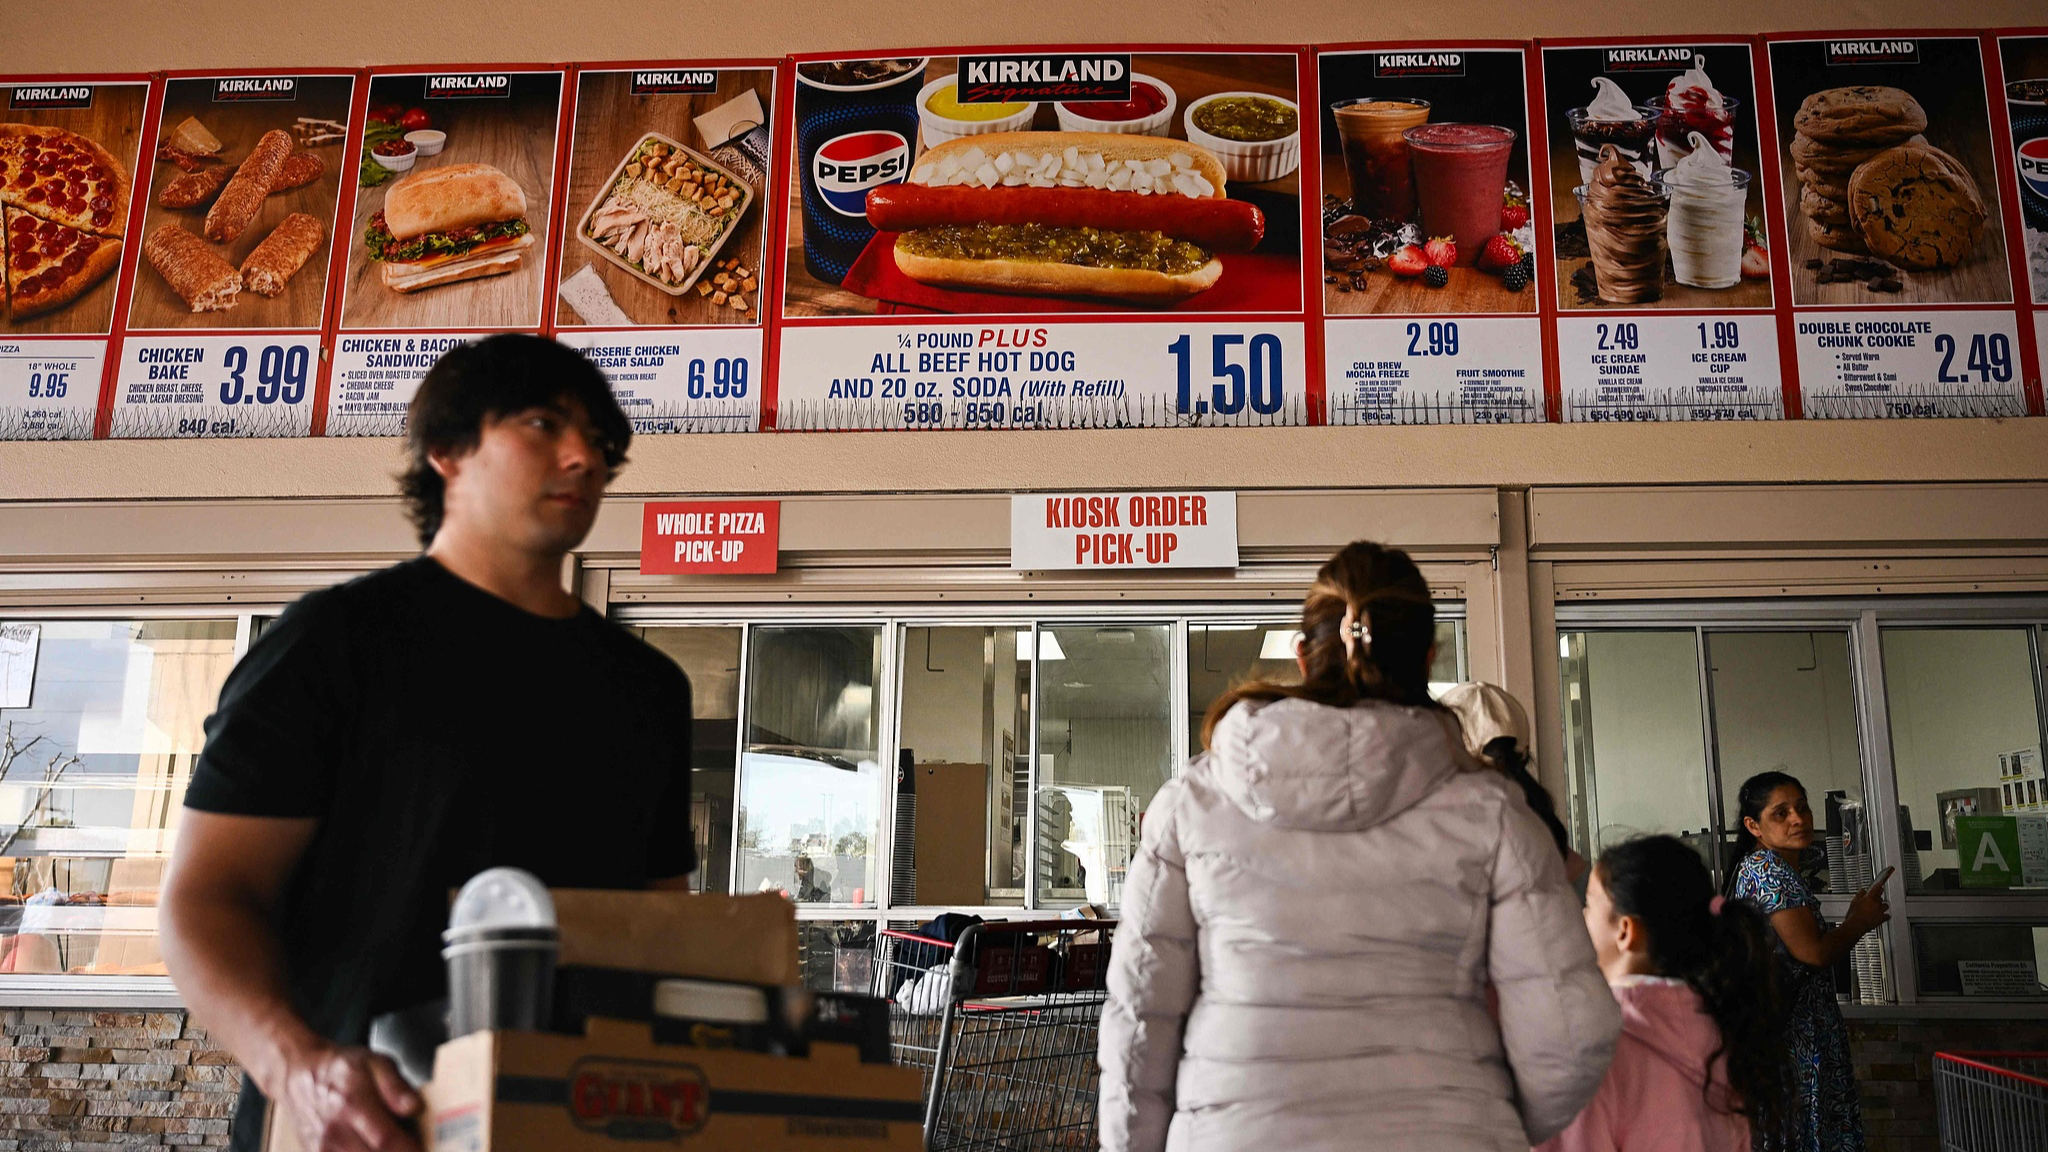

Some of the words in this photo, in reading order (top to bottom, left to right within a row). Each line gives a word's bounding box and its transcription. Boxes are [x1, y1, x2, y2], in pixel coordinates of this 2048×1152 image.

[1831, 42, 1914, 55] KIRKLAND
[1379, 54, 1461, 67] KIRKLAND
[1609, 49, 1691, 62] KIRKLAND
[968, 60, 1124, 83] KIRKLAND
[431, 76, 507, 89] KIRKLAND
[637, 72, 714, 85] KIRKLAND
[219, 79, 294, 92] KIRKLAND
[15, 88, 90, 101] KIRKLAND
[967, 82, 1124, 103] Signature
[818, 153, 905, 183] PEPSI
[1799, 322, 1850, 334] DOUBLE
[1855, 322, 1931, 334] CHOCOLATE
[917, 333, 973, 348] POUND
[978, 328, 1048, 348] PLUS
[1406, 322, 1459, 356] 2.99
[1596, 323, 1639, 350] 2.49
[1698, 321, 1739, 349] 1.99
[1818, 336, 1863, 348] CHUNK
[1867, 335, 1915, 347] COOKIE
[342, 339, 400, 352] CHICKEN
[405, 339, 416, 352] &
[635, 346, 680, 356] CHICKEN
[138, 348, 204, 362] CHICKEN
[366, 354, 439, 368] SANDWICH
[1592, 354, 1608, 364] ICE
[1611, 354, 1646, 363] CREAM
[1692, 353, 1708, 362] ICE
[1710, 353, 1747, 362] CREAM
[1934, 333, 2013, 383] 2.49
[44, 363, 77, 371] WHOLE
[630, 357, 664, 367] SALAD
[871, 353, 910, 373] ALL
[919, 352, 970, 373] BEEF
[978, 351, 1022, 372] HOT
[1030, 351, 1075, 372] DOG
[1353, 362, 1375, 370] COLD
[1377, 361, 1402, 370] BREW
[1710, 364, 1730, 373] CUP
[1843, 363, 1851, 371] All
[1852, 363, 1869, 371] Butter
[149, 365, 189, 379] BAKE
[219, 345, 310, 405] 3.99
[347, 371, 368, 380] SLICED
[369, 370, 384, 379] OVEN
[385, 370, 411, 379] ROASTED
[1168, 333, 1282, 415] 1.50
[1346, 370, 1376, 378] MOCHA
[1378, 369, 1409, 378] FREEZE
[1456, 370, 1480, 378] FRUIT
[1482, 369, 1525, 377] SMOOTHIE
[1599, 365, 1640, 375] SUNDAE
[688, 358, 749, 399] 6.99
[1844, 373, 1876, 381] Bittersweet
[1877, 373, 1882, 381] &
[1883, 373, 1897, 381] Semi
[29, 373, 69, 398] 9.95
[129, 383, 154, 393] CHICKEN
[346, 381, 372, 390] CHEDDAR
[373, 381, 395, 390] CHEESE
[829, 378, 874, 399] AND
[881, 378, 907, 398] 20
[914, 381, 943, 398] oz.
[953, 377, 1012, 398] SODA
[1020, 379, 1066, 400] (With
[1071, 379, 1125, 400] Refill)
[126, 394, 148, 404] BACON,
[150, 394, 173, 403] CAESAR
[174, 394, 204, 403] DRESSING
[345, 392, 365, 401] BACON
[367, 392, 380, 400] JAM
[904, 403, 943, 423] 580
[967, 402, 1005, 423] 850
[179, 419, 208, 434] 840
[635, 421, 654, 431] 710
[1046, 497, 1120, 528] KIOSK
[1129, 495, 1207, 527] ORDER
[657, 513, 714, 535] WHOLE
[719, 512, 765, 534] PIZZA
[674, 540, 744, 563] PICK-UP
[1076, 533, 1178, 564] PICK-UP
[1972, 832, 2010, 872] A
